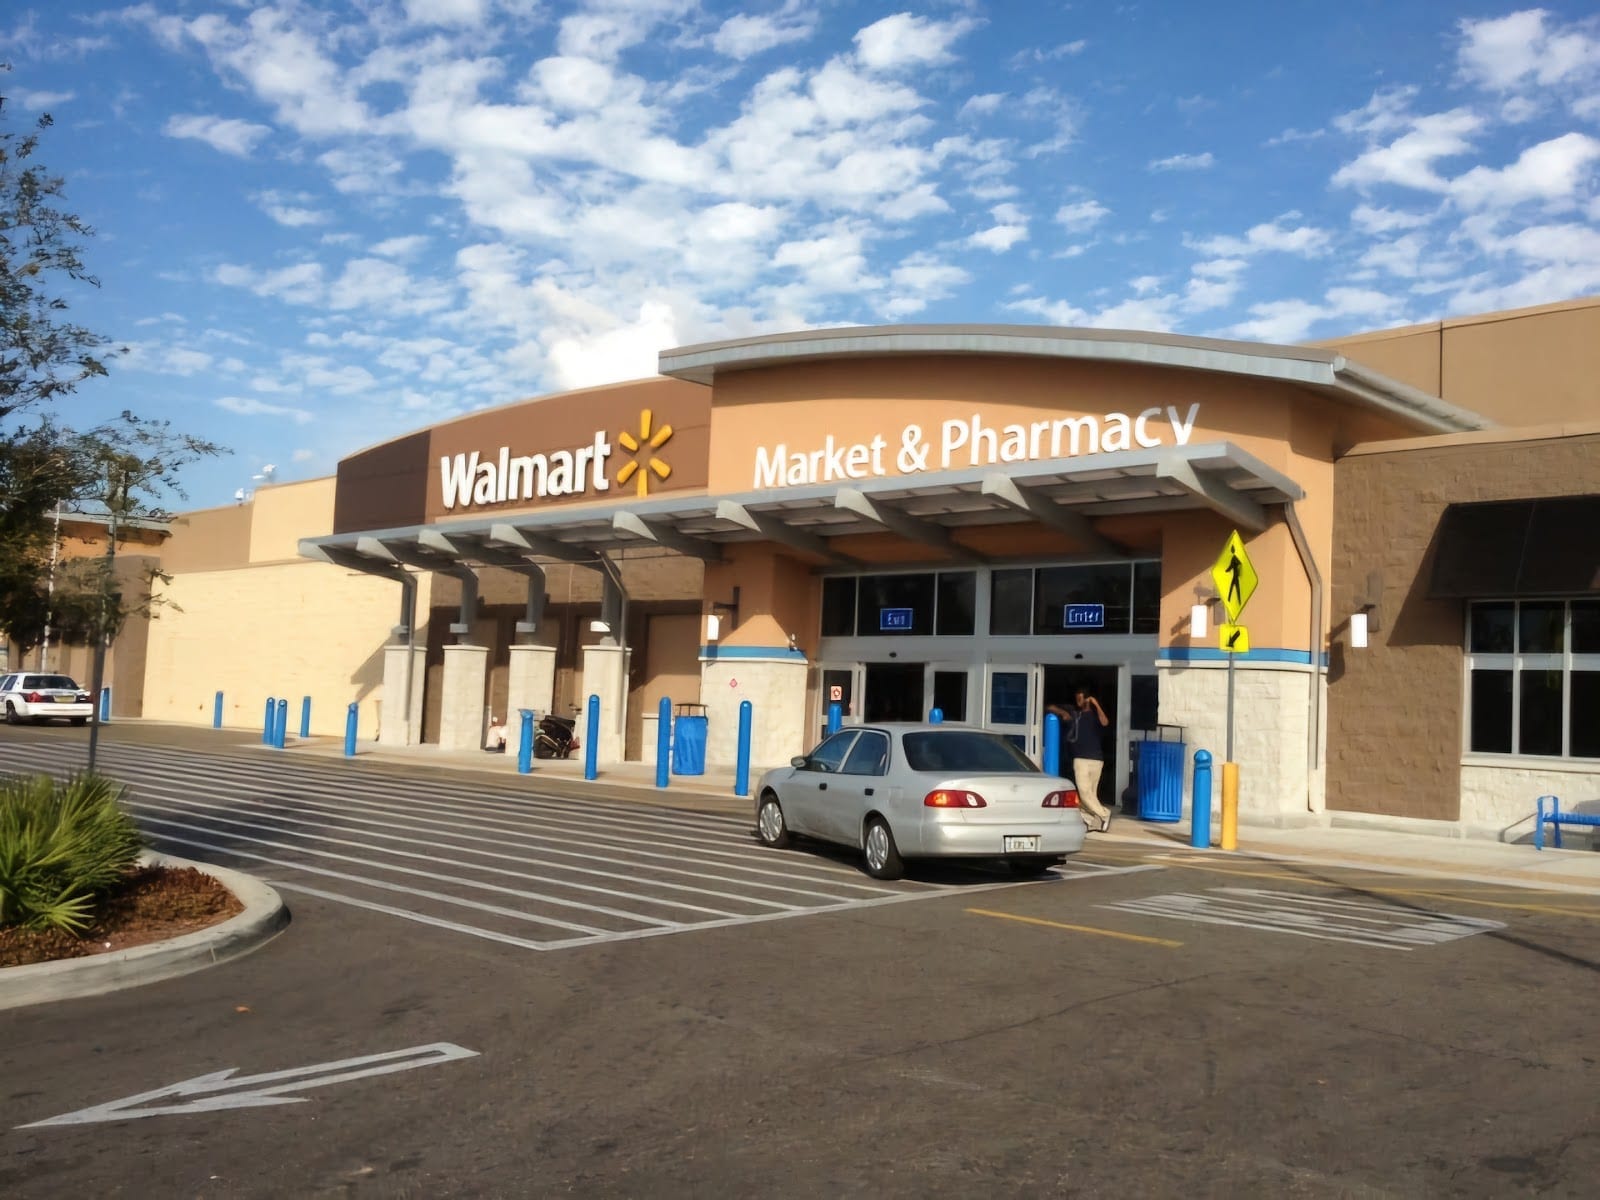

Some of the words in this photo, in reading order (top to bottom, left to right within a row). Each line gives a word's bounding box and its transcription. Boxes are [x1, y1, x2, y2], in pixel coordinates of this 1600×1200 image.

[440, 430, 611, 510] Walmart
[752, 434, 887, 490] Market
[896, 423, 929, 475] &
[941, 402, 1200, 469] Pharmacy
